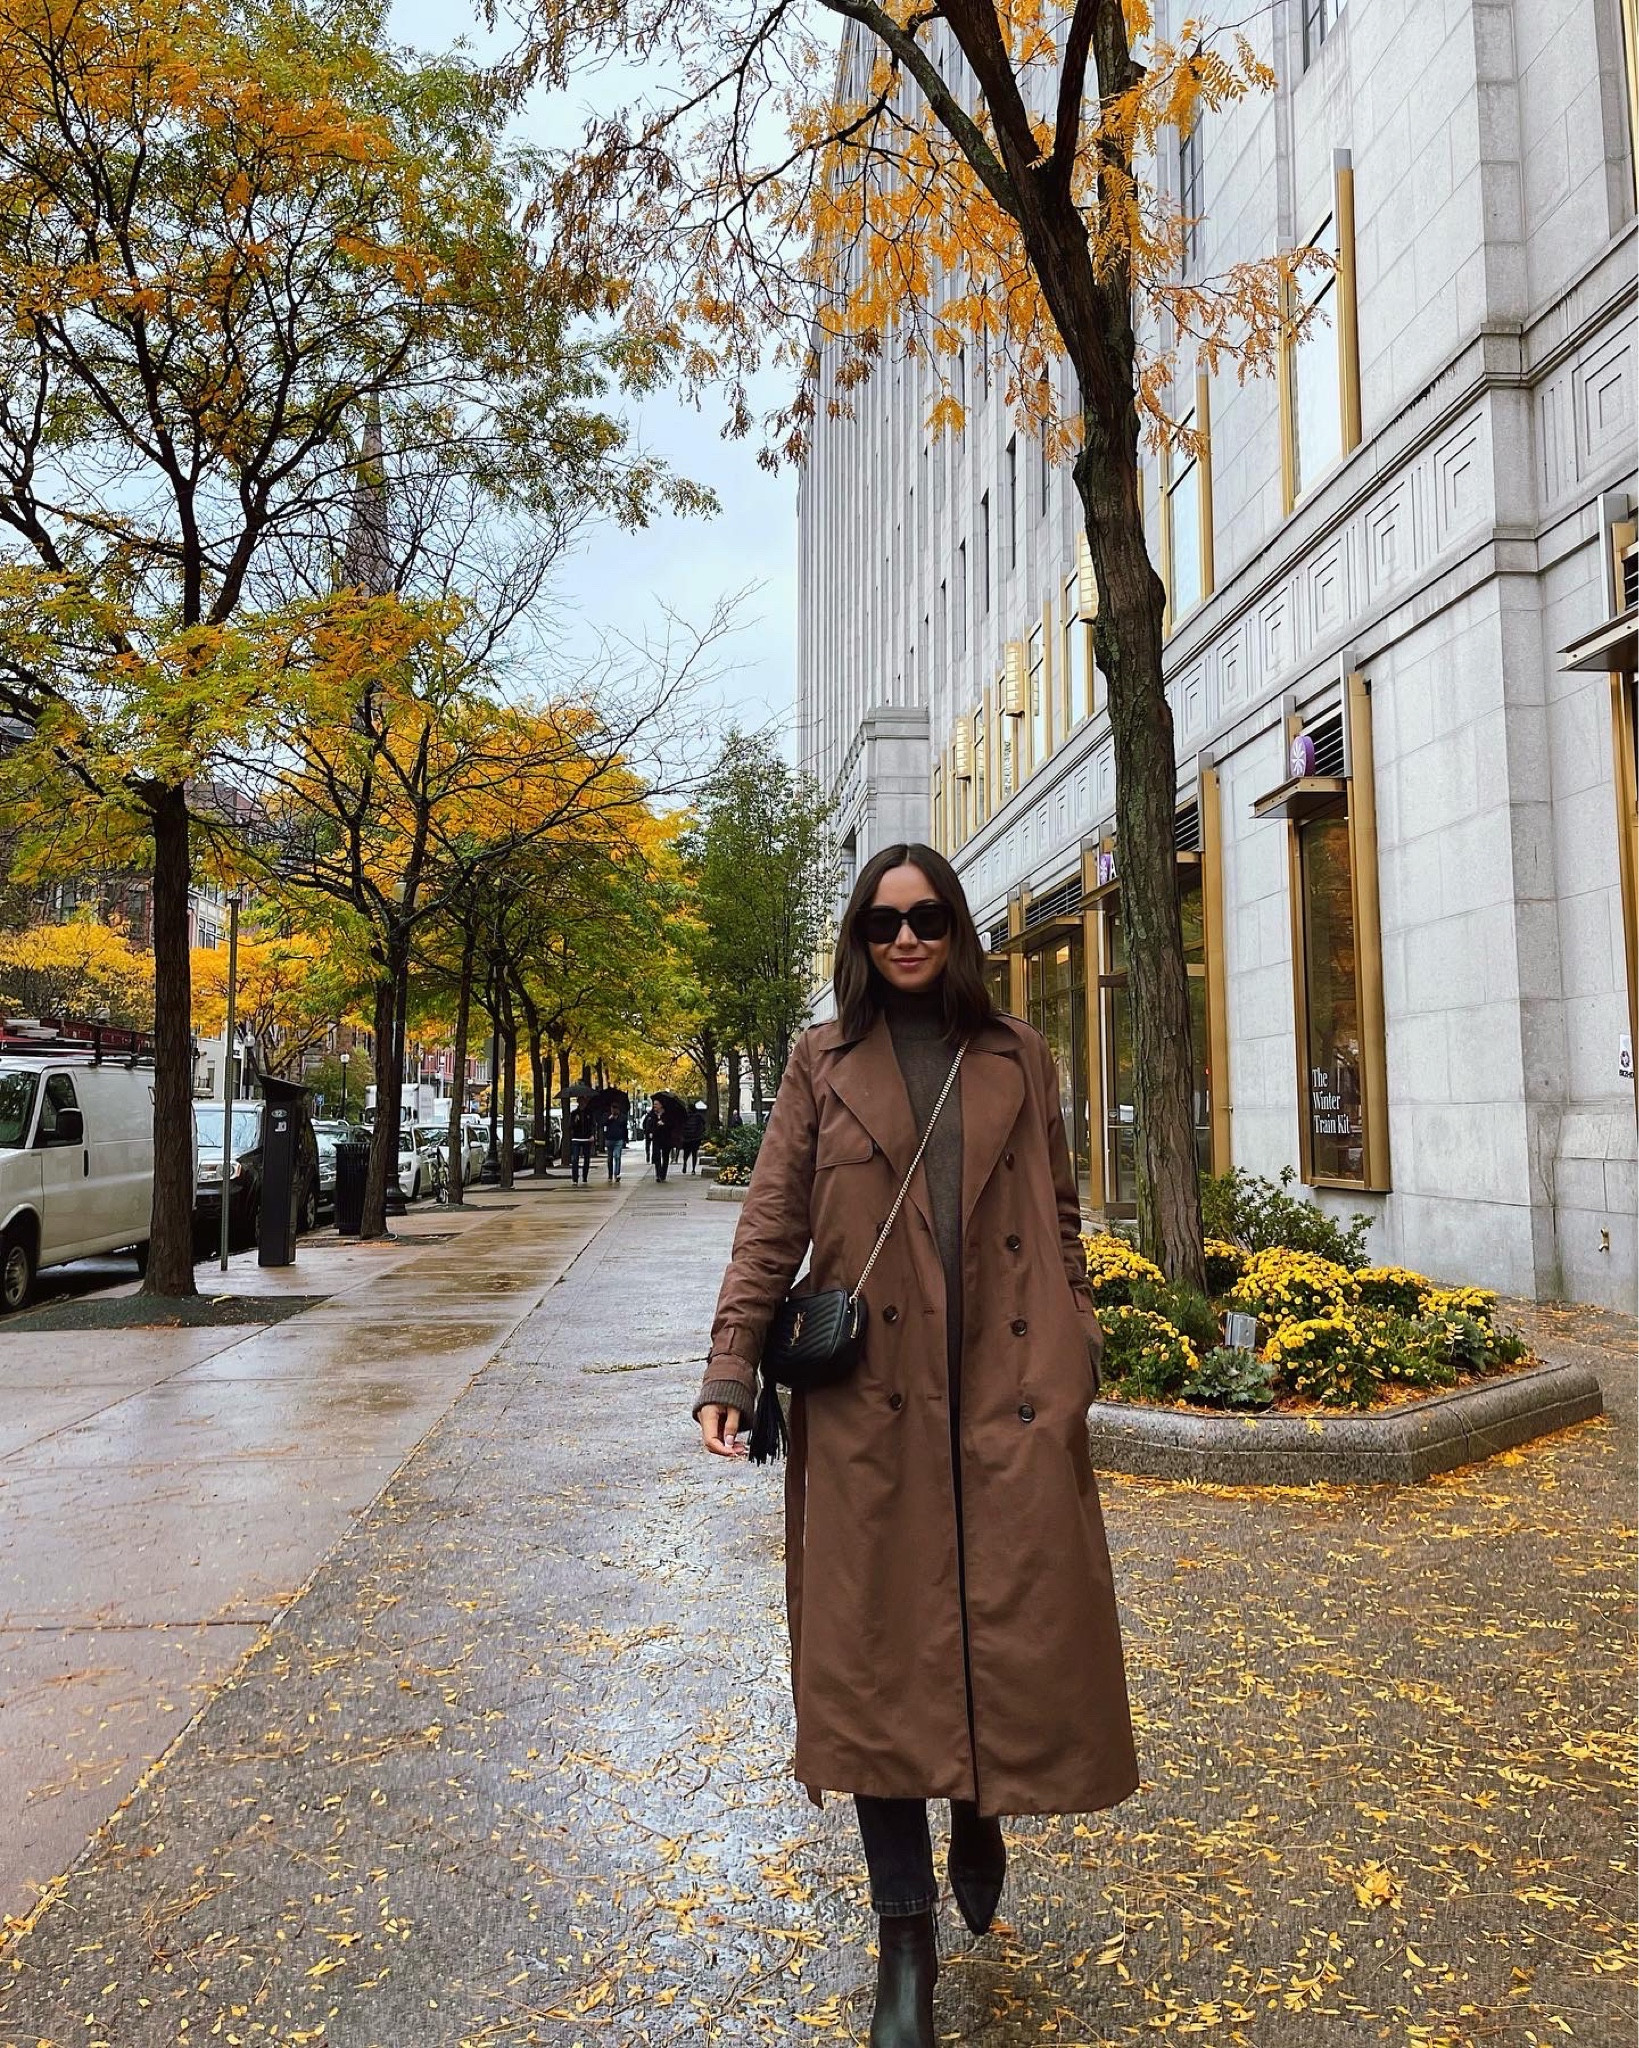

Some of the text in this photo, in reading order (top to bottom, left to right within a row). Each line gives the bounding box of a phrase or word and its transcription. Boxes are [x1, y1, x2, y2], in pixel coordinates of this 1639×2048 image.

[1312, 1067, 1328, 1087] The
[1313, 1091, 1341, 1110] Winter
[1314, 1113, 1350, 1134] Train Kit
